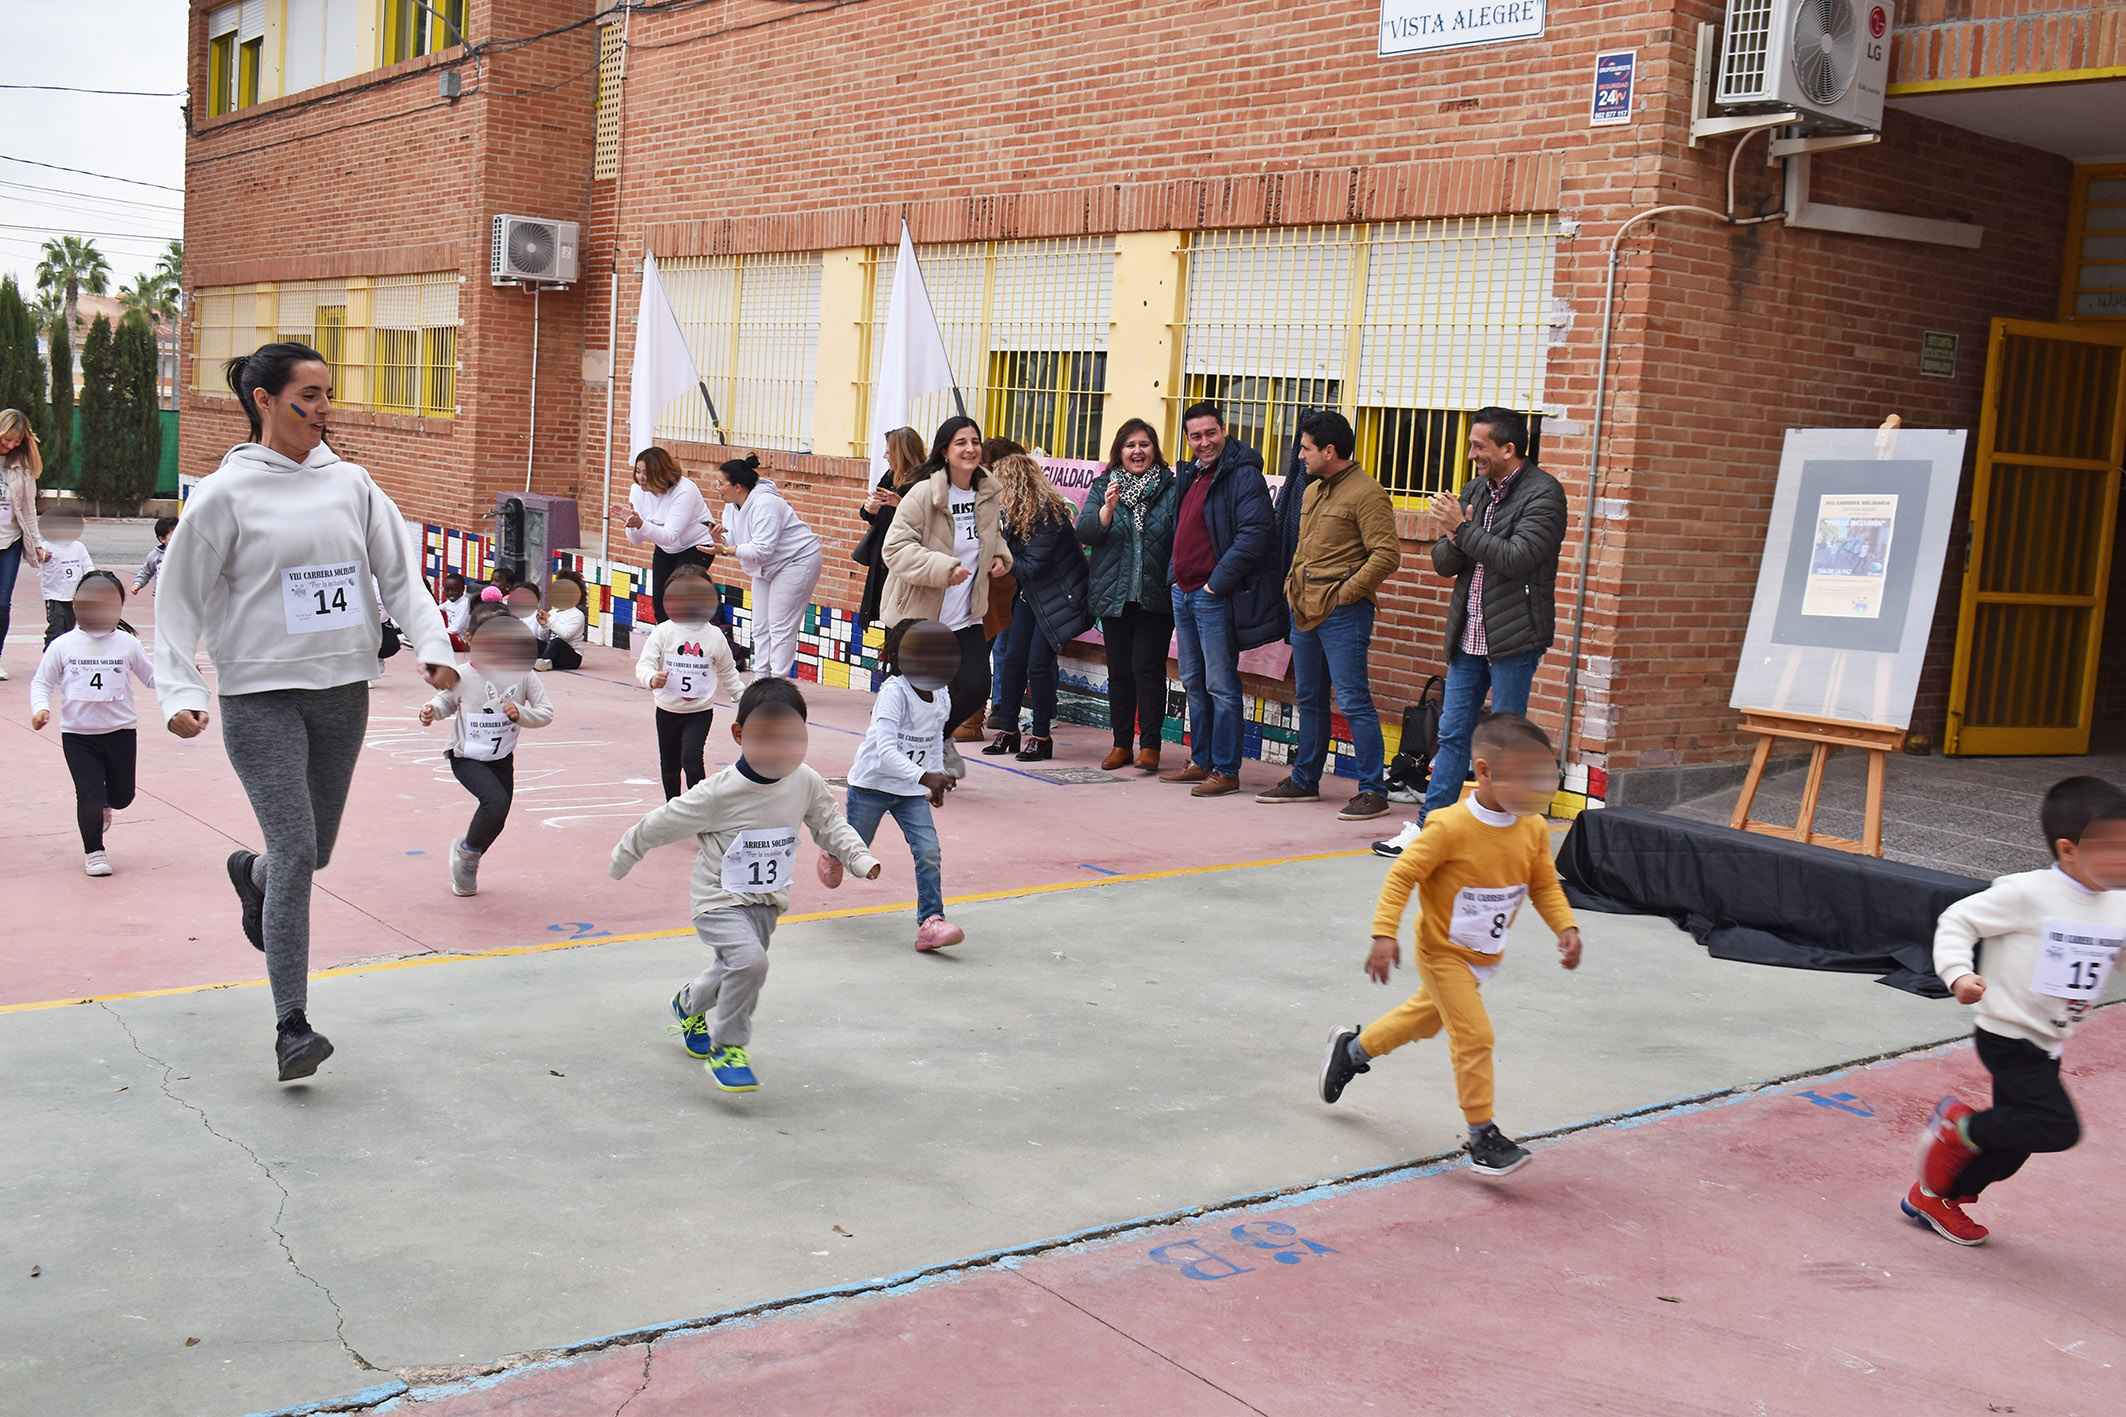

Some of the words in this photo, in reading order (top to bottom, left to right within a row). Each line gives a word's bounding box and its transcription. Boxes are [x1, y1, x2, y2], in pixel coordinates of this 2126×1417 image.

[1384, 14, 1444, 38] "VISTA
[1452, 0, 1541, 31] ALEGRE"
[1867, 42, 1882, 61] LG
[1598, 82, 1629, 90] SEGURIDAD
[1041, 466, 1095, 489] GUALDAD
[65, 568, 73, 578] 9
[288, 572, 302, 581] VIII
[303, 570, 334, 580] CARRERA
[313, 587, 347, 615] 14
[89, 672, 103, 690] 4
[681, 676, 692, 692] 5
[491, 737, 503, 755] 7
[906, 750, 926, 767] 12
[748, 859, 777, 885] 13
[546, 922, 613, 940] 2
[1490, 912, 1506, 939] 8
[2066, 960, 2102, 990] 15
